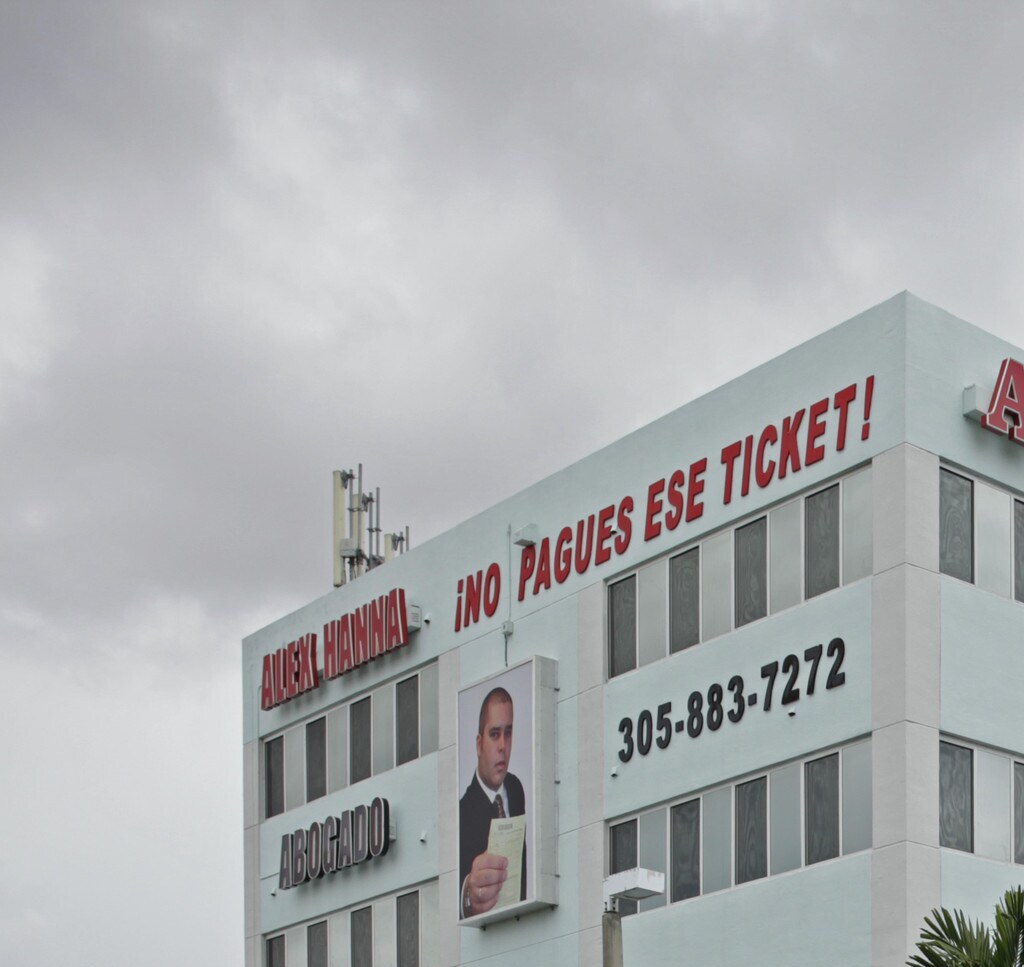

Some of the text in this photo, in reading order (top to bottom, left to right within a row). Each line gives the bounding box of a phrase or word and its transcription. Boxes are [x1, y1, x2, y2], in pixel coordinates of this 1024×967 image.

[518, 496, 633, 601] PAGUES
[644, 457, 707, 541] ESE
[721, 375, 874, 505] TICKET!
[261, 588, 409, 711] ALEX HANNA
[618, 637, 846, 763] 305-883-7272
[279, 797, 390, 890] ABOGADO
